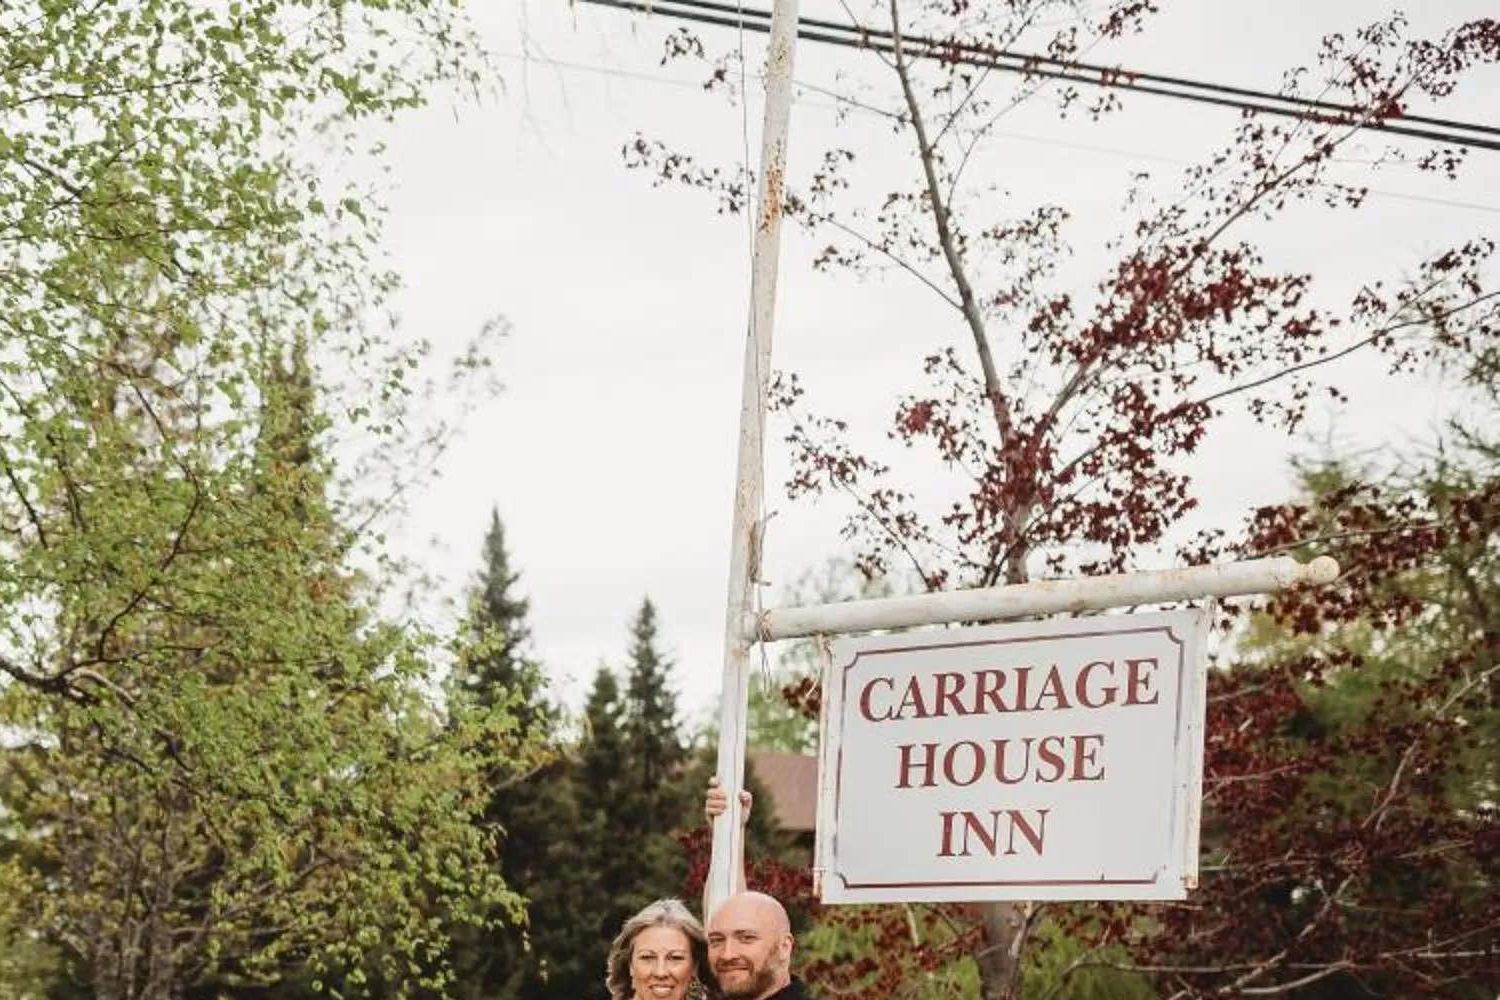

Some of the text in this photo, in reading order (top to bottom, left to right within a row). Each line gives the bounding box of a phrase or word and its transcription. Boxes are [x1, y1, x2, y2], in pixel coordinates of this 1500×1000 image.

[859, 657, 1160, 723] CARRIAGE
[894, 734, 1106, 789] HOUSE
[936, 809, 1051, 858] INN
